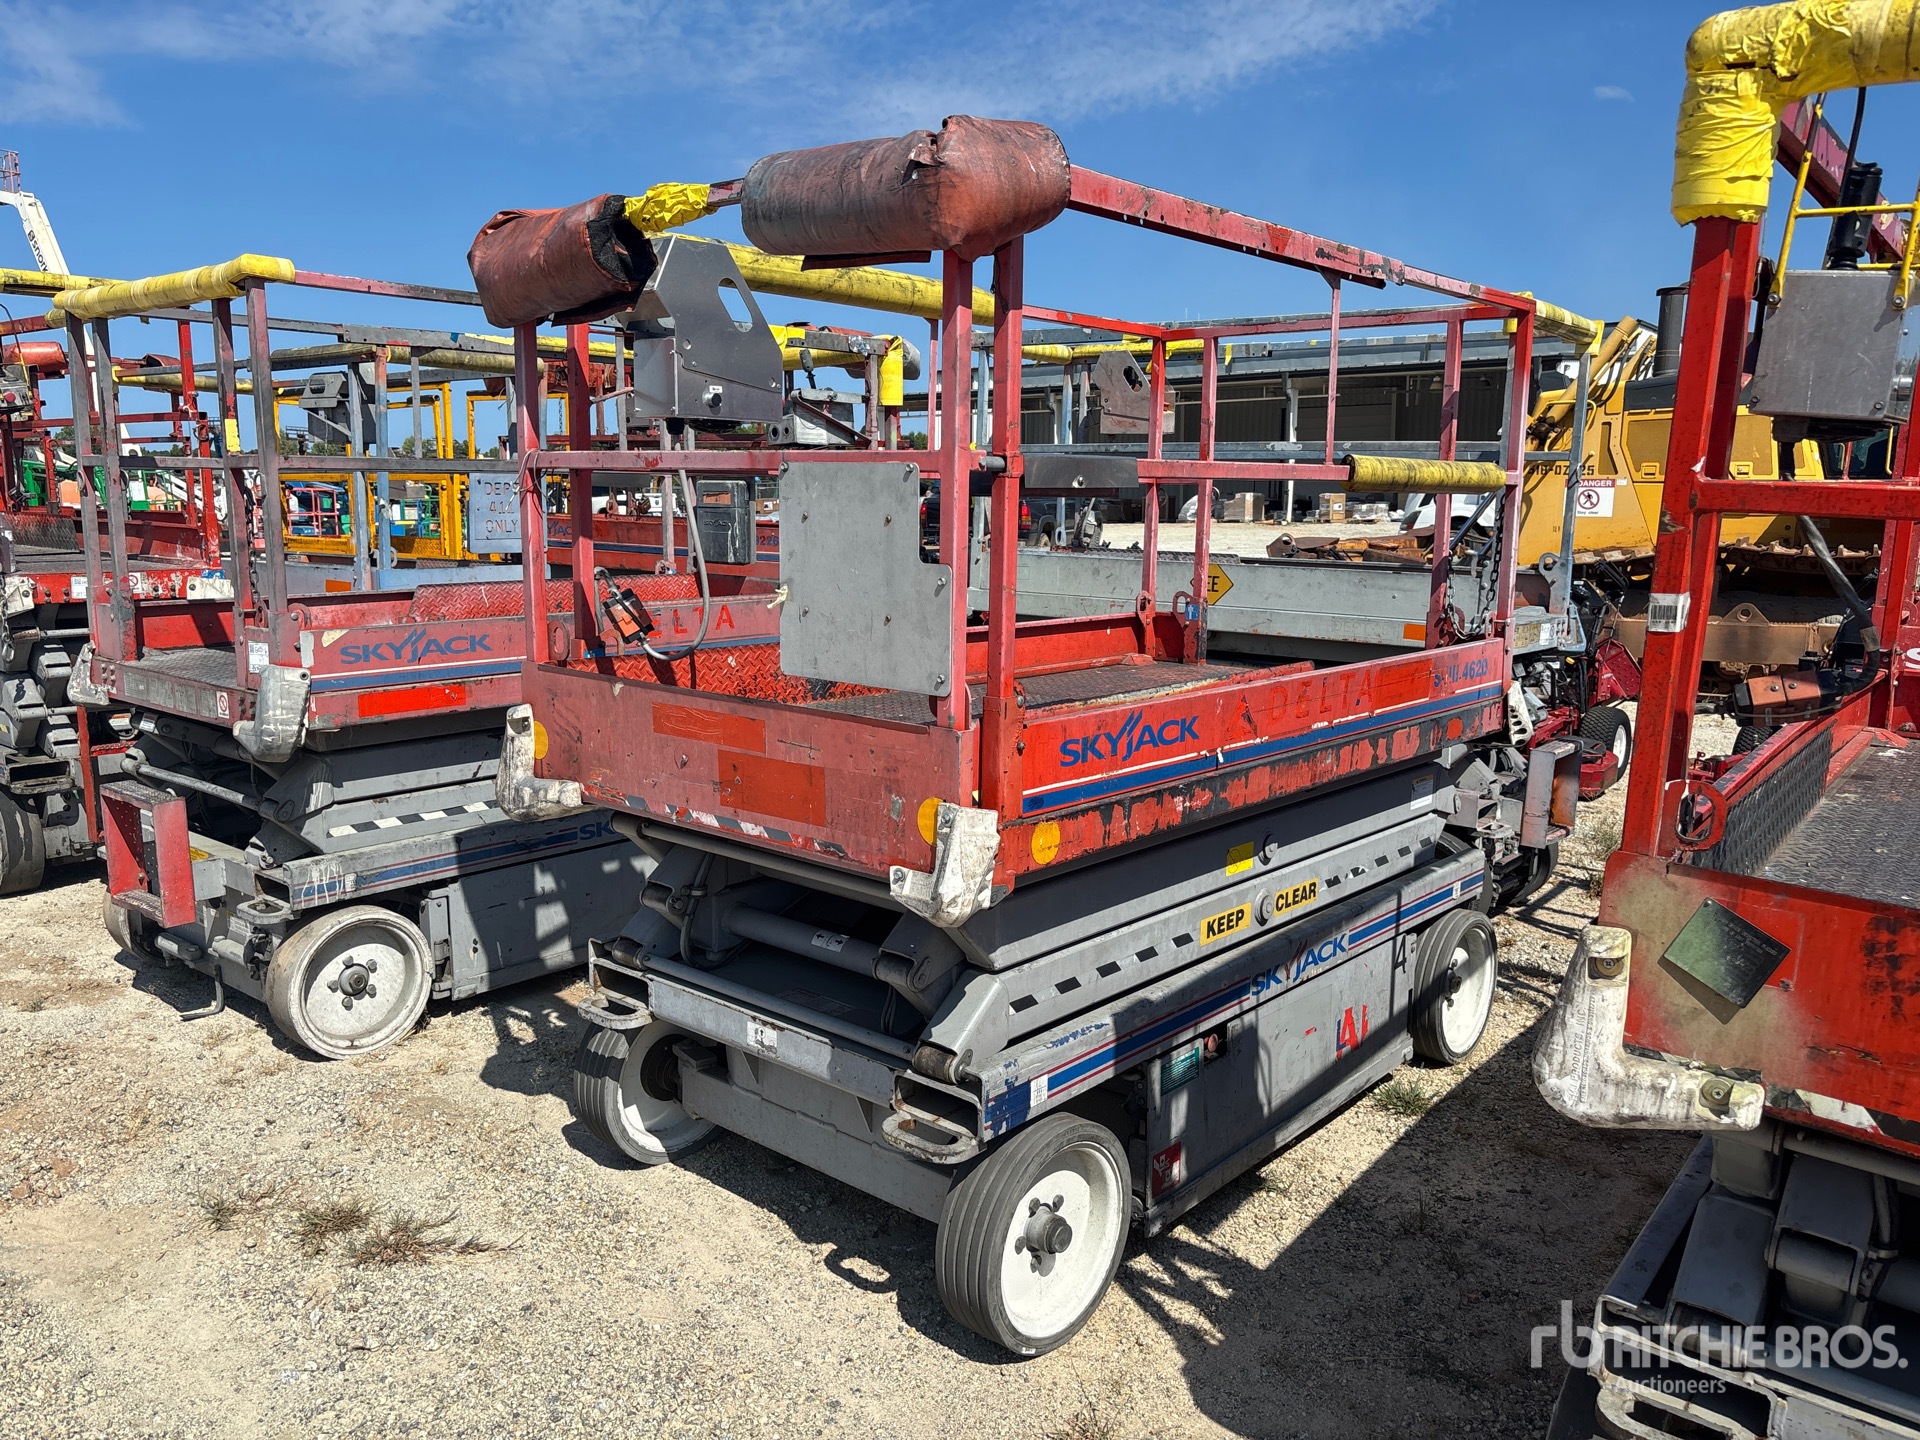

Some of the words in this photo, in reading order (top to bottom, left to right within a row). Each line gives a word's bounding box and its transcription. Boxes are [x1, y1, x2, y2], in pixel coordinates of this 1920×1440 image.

[485, 519, 518, 533] ONLY
[339, 627, 493, 665] SKYJACK
[1267, 669, 1373, 722] DELTA
[1059, 709, 1200, 768] SKYJACK
[1206, 908, 1245, 940] KEEP
[1275, 881, 1318, 913] CLEAR
[1250, 933, 1350, 997] SKYJACK
